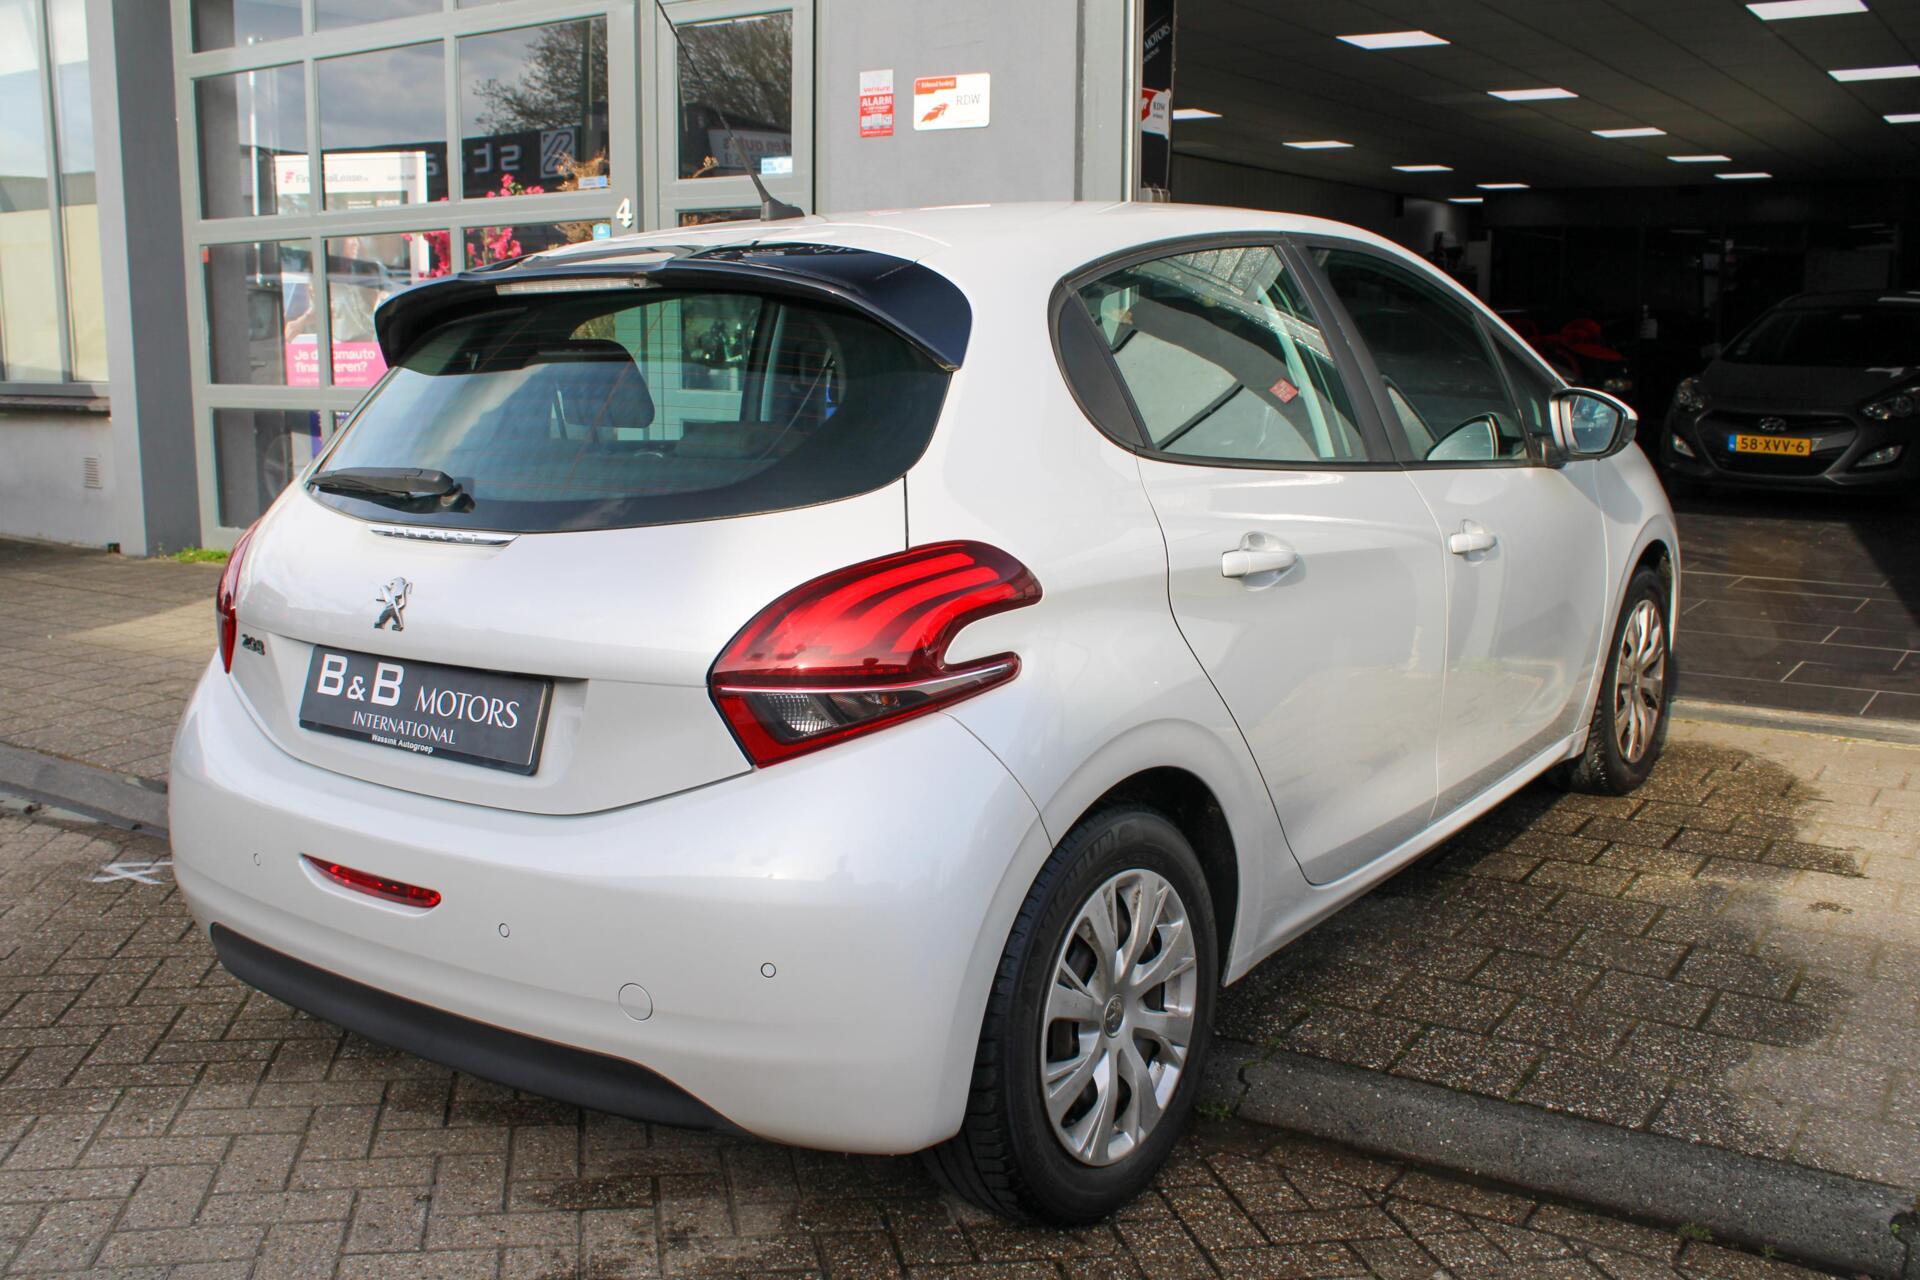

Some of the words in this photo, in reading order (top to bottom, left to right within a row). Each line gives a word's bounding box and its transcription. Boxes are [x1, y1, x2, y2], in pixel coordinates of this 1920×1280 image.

[862, 96, 892, 107] ALARM
[956, 94, 980, 105] RDW
[615, 198, 633, 228] 4
[293, 349, 309, 361] Je
[1740, 437, 1805, 454] 58-XVV-6
[242, 633, 266, 656] 208
[415, 685, 520, 729] MOTORS
[352, 710, 456, 745] INTERNATIONAL
[371, 734, 397, 746] Wassink
[397, 740, 434, 754] Autogroep
